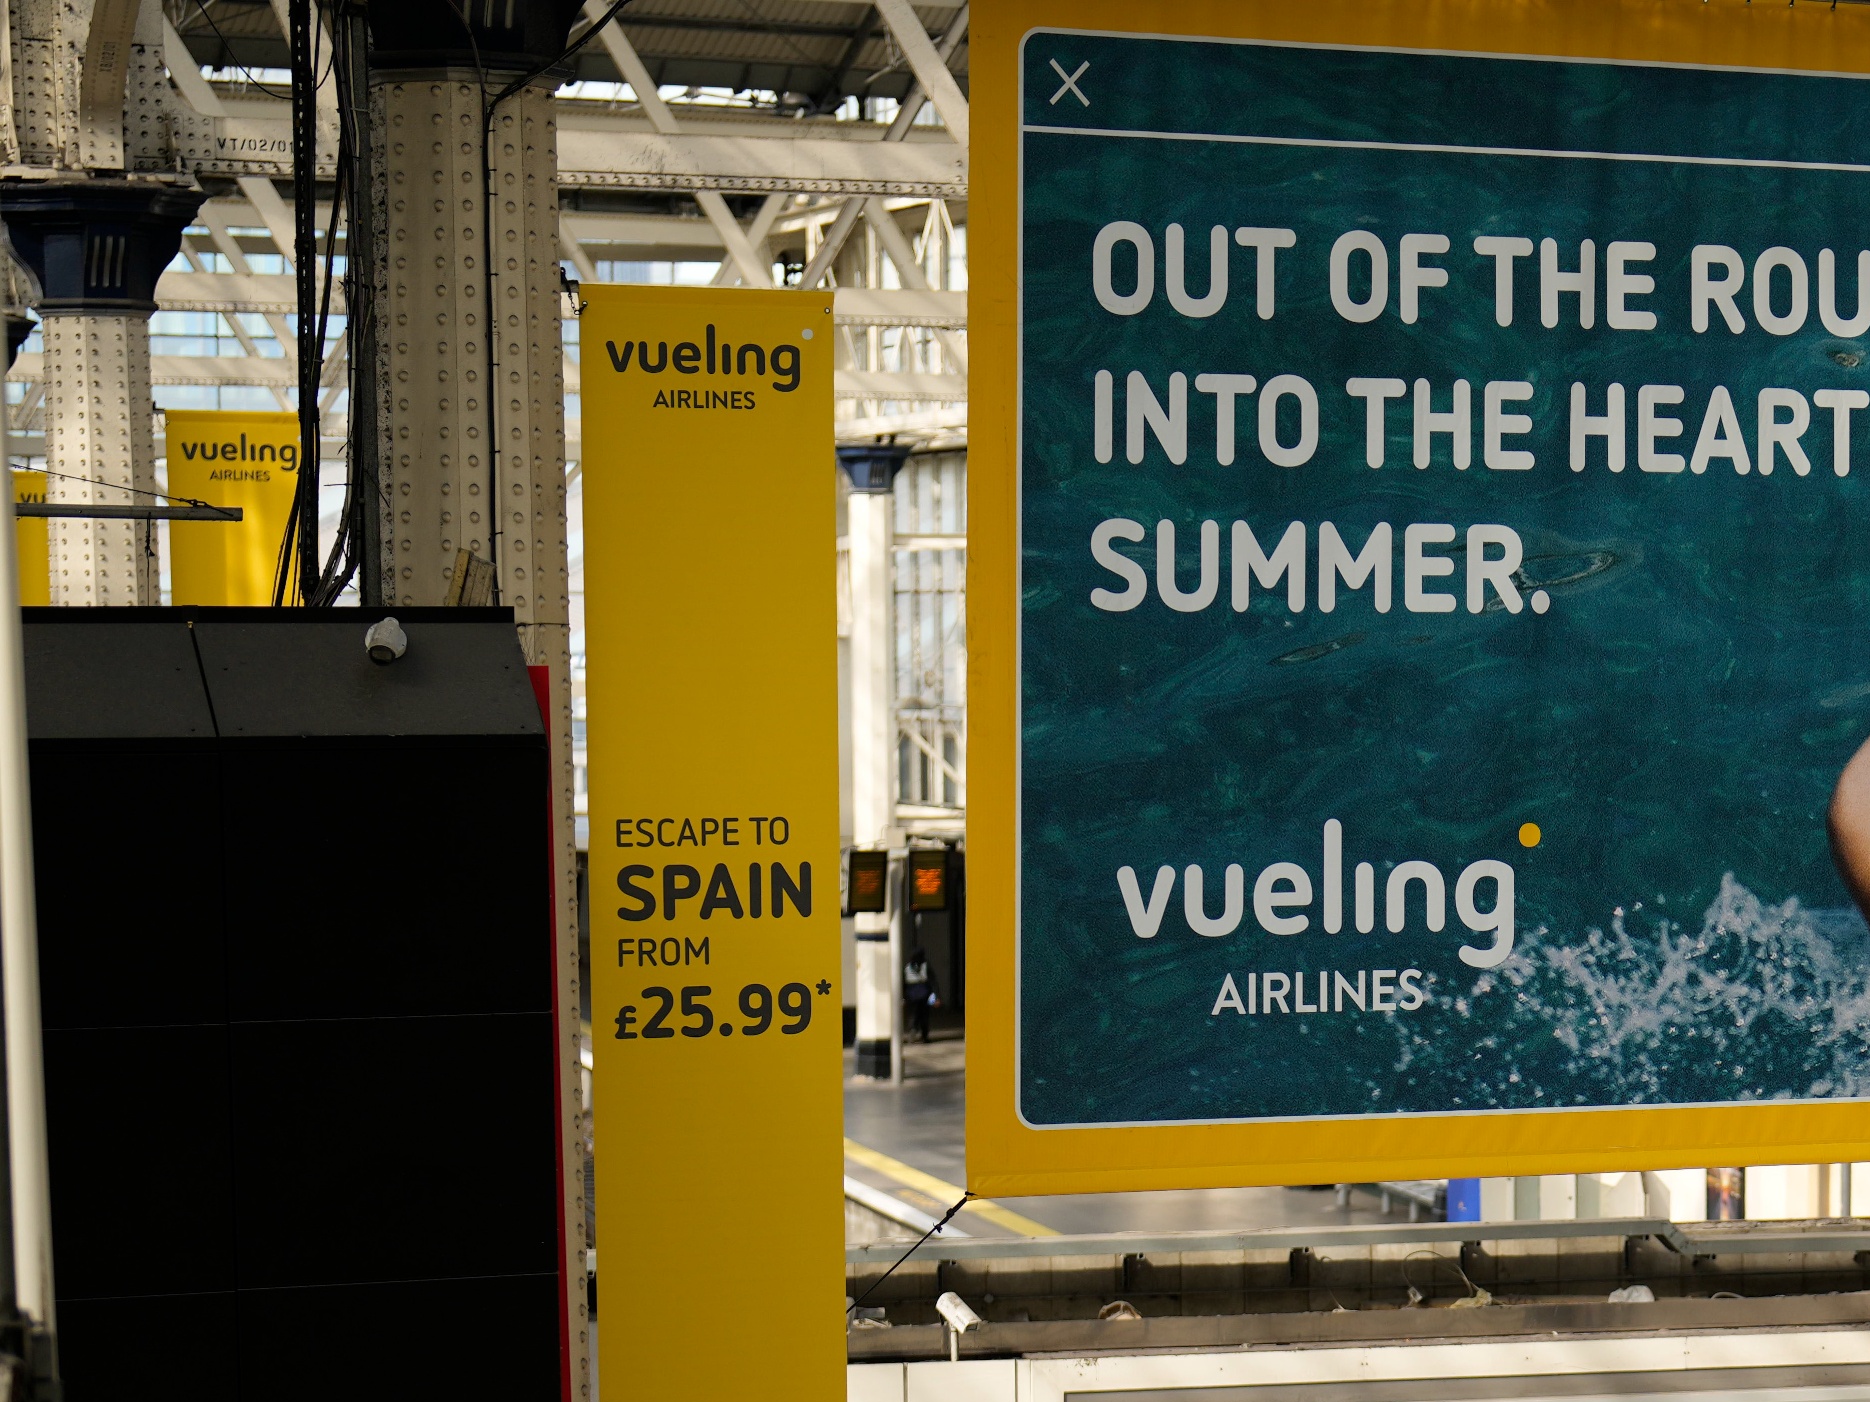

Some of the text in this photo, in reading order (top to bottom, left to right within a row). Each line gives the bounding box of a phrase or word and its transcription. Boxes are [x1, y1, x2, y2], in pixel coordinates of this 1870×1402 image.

[1091, 220, 1296, 321] OUT
[1328, 230, 1451, 326] OF
[1473, 236, 1657, 331] THE
[605, 323, 800, 392] vueling
[652, 389, 756, 410] AIRLINES
[1093, 369, 1319, 468] INTO
[1345, 376, 1535, 472] THE
[1568, 382, 1870, 478] HEART
[181, 433, 297, 471] vueling
[209, 469, 271, 482] AIRLINES
[1088, 518, 1551, 616] SUMMER.
[615, 816, 790, 848] ESCAPE TO
[616, 861, 812, 921] SPAIN
[1117, 818, 1515, 968] vueling
[618, 936, 710, 967] FROM
[1211, 969, 1424, 1016] AIRLINES
